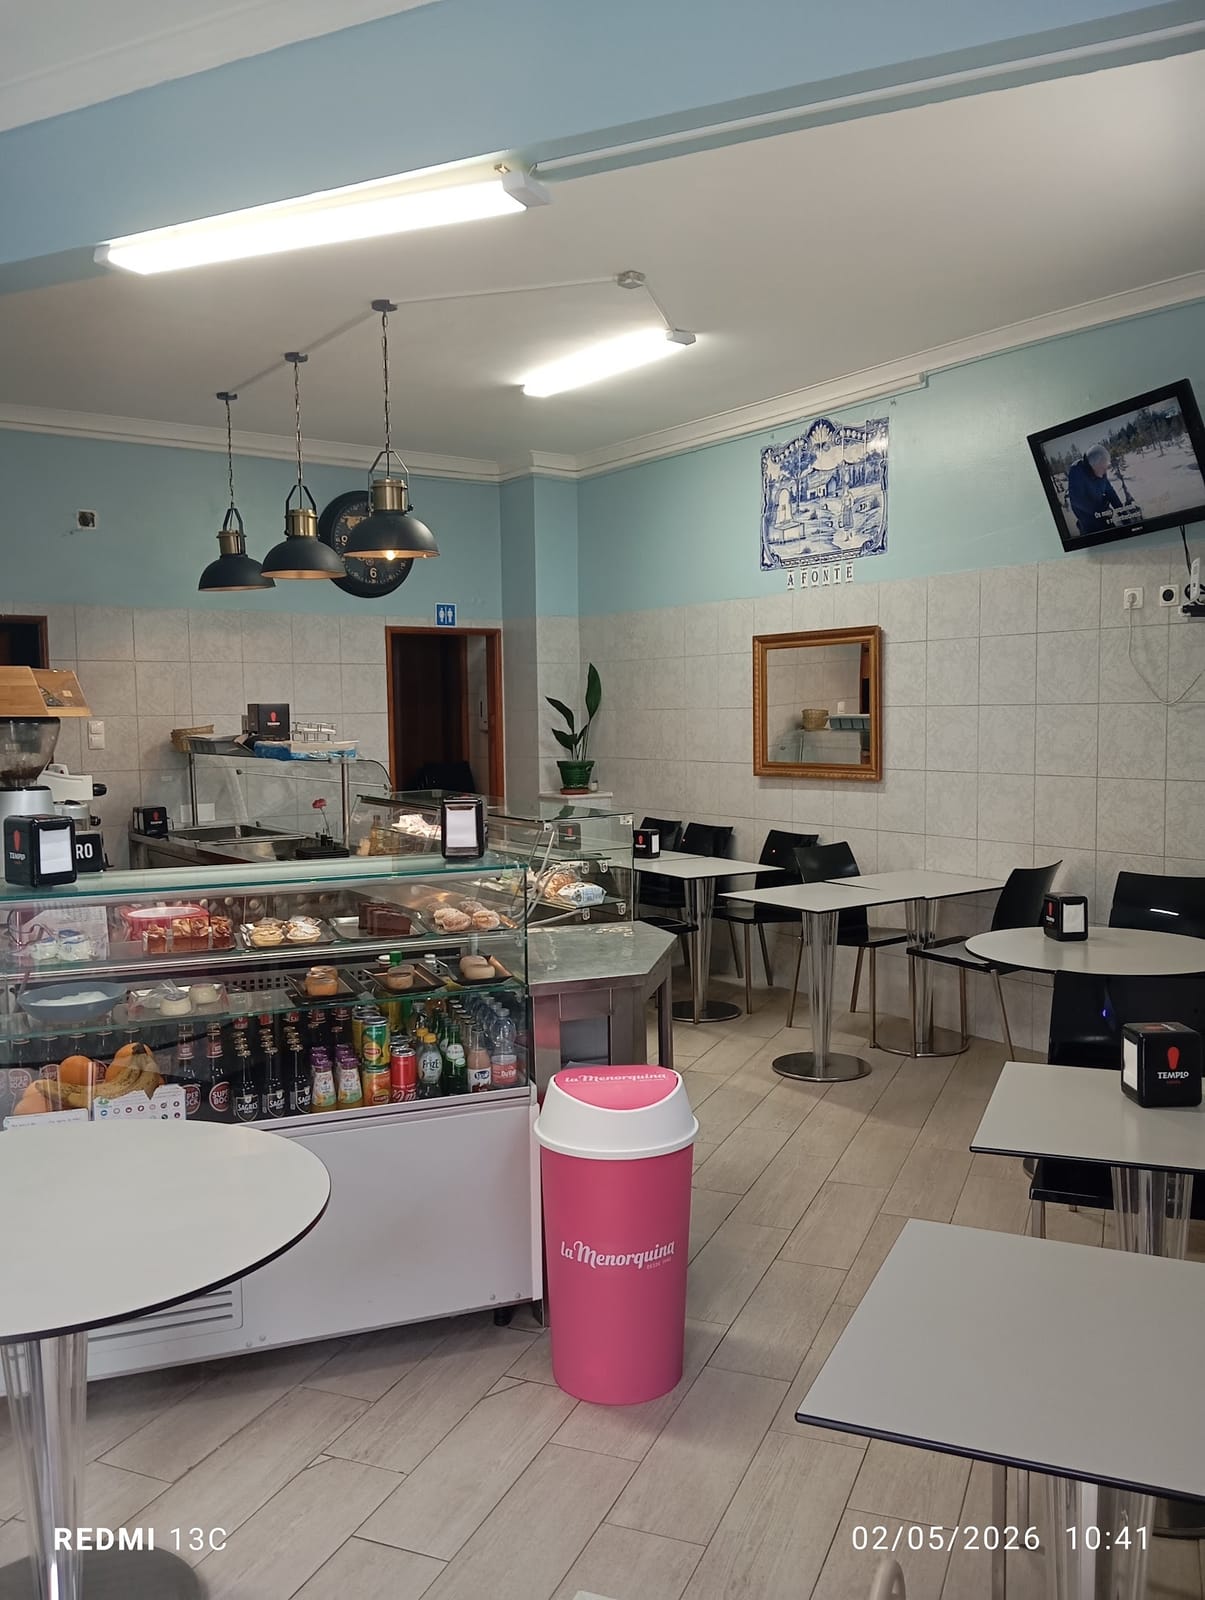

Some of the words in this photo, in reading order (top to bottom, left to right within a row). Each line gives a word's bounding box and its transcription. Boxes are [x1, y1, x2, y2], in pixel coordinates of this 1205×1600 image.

[369, 567, 377, 578] 6
[787, 574, 794, 586] A
[801, 566, 853, 584] FONTE
[579, 1073, 667, 1083] Menorquina
[1156, 1071, 1190, 1080] TEMPLO
[186, 1090, 199, 1099] PER
[185, 1098, 199, 1106] OCK
[560, 1240, 574, 1260] la
[573, 1240, 676, 1270] Menorquina
